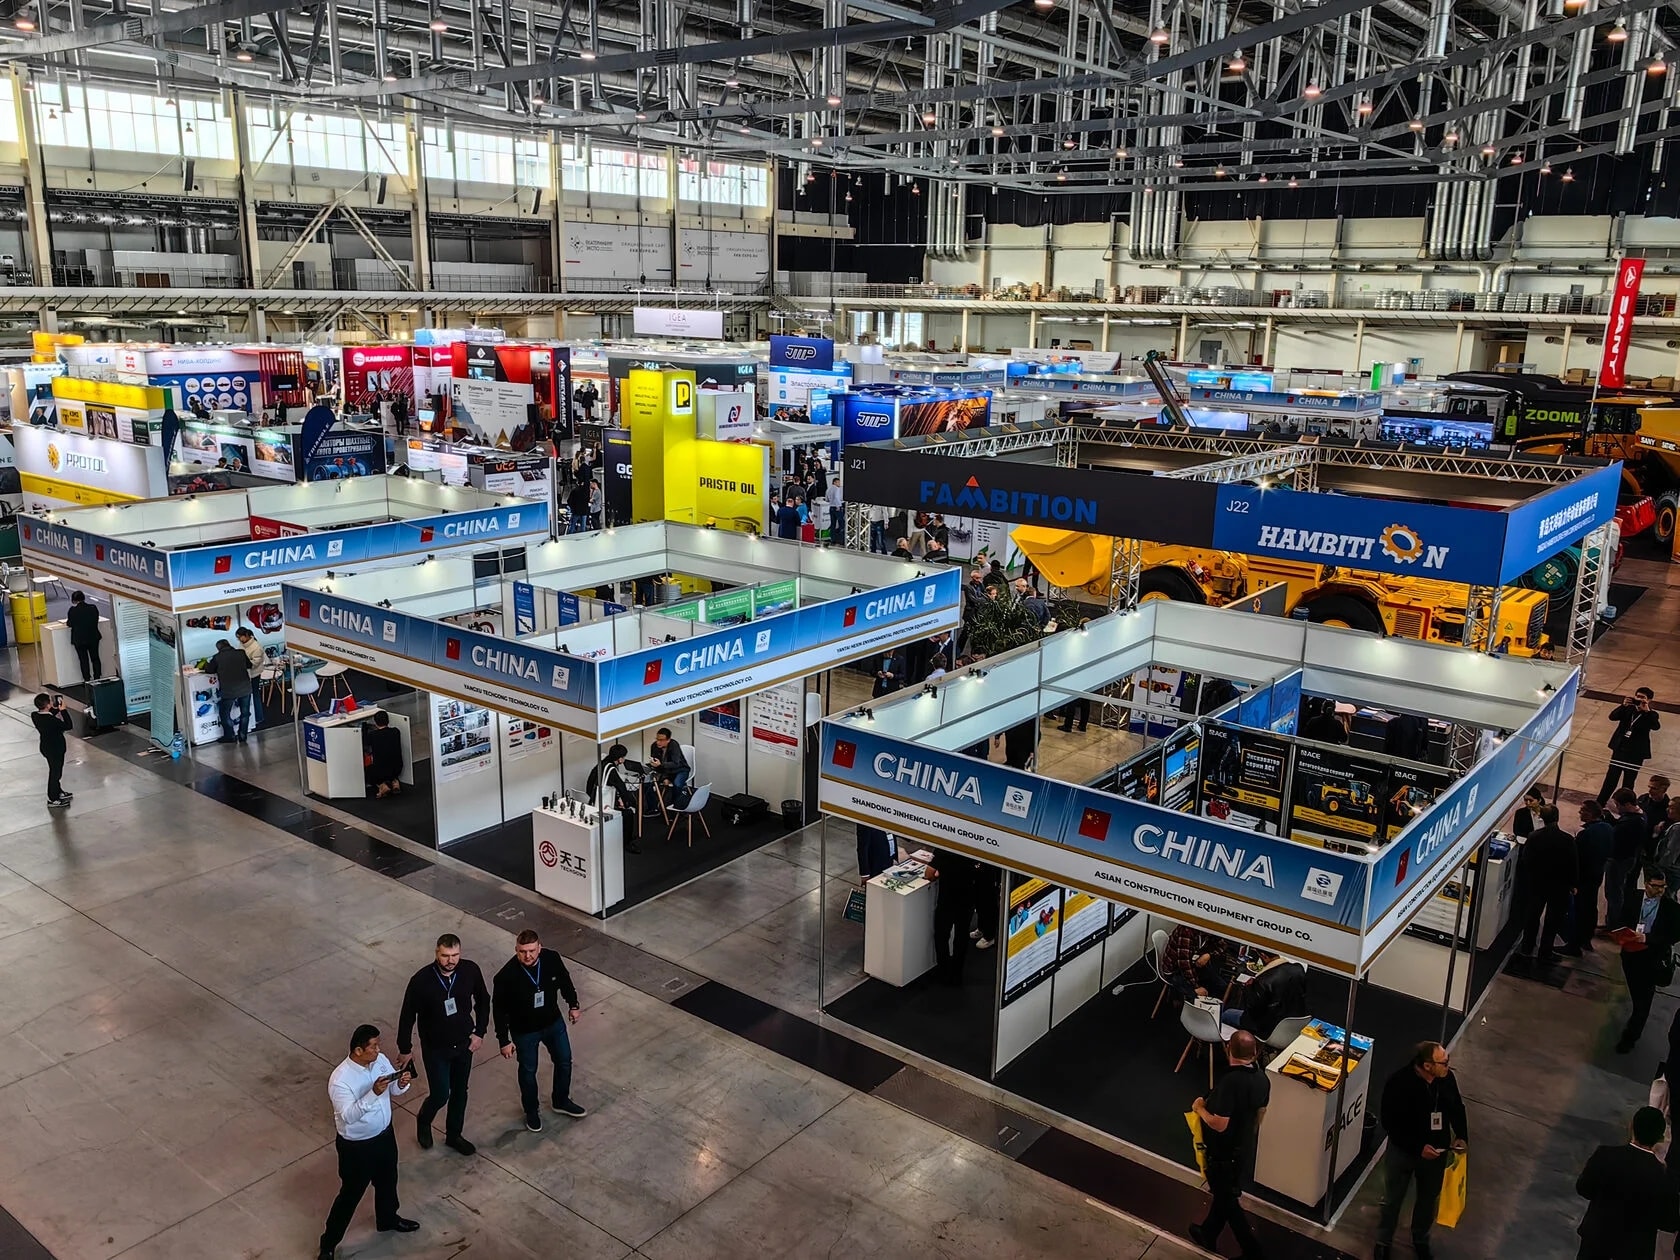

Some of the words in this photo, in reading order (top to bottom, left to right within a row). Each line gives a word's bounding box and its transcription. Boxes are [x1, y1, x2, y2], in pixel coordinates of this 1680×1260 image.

[669, 312, 686, 322] IGEA
[738, 366, 754, 374] IGEA
[1022, 380, 1045, 388] CHINA
[1082, 383, 1106, 392] CHINA
[1214, 392, 1242, 400] CHINA
[1298, 397, 1328, 406] CHINA
[1640, 436, 1656, 446] SANY
[66, 452, 107, 473] PROTOL
[495, 461, 515, 472] UCS
[850, 458, 866, 470] J21
[700, 476, 736, 492] PRISTA
[740, 482, 756, 495] OIL
[920, 476, 1098, 525] FAMBITION
[1226, 500, 1249, 514] J22
[444, 516, 499, 538] CHINA
[36, 528, 70, 550] CHINA
[110, 548, 149, 574] CHINA
[244, 544, 316, 569] CHINA
[224, 586, 246, 594] TAIZHOU
[865, 590, 916, 620] CHINA
[318, 604, 374, 636] CHINA
[892, 626, 914, 636] PROTECTION
[346, 650, 369, 660] MACHINERY
[471, 646, 541, 684] CHINA
[674, 637, 745, 676] CHINA
[713, 678, 744, 692] TECHNOLOGY
[482, 690, 508, 702] TECHGONG
[508, 697, 541, 710] TECHNOLOGY
[873, 752, 982, 806] CHINA
[852, 796, 892, 815] SHANDONG
[892, 808, 931, 827] JINHENGLI
[932, 818, 956, 834] CHAIN
[957, 827, 985, 842] GROUP
[986, 836, 1000, 848] CO.
[1416, 800, 1462, 865] CHINA
[560, 850, 586, 872] 天工
[1132, 824, 1275, 889] CHINA
[560, 865, 587, 878] TECHGONG
[1094, 870, 1122, 885] ASIAN
[1124, 878, 1195, 906] CONSTRUCTION
[1197, 901, 1254, 924] EQUIPMENT
[1256, 918, 1294, 936] GROUP
[1295, 930, 1312, 942] CO.
